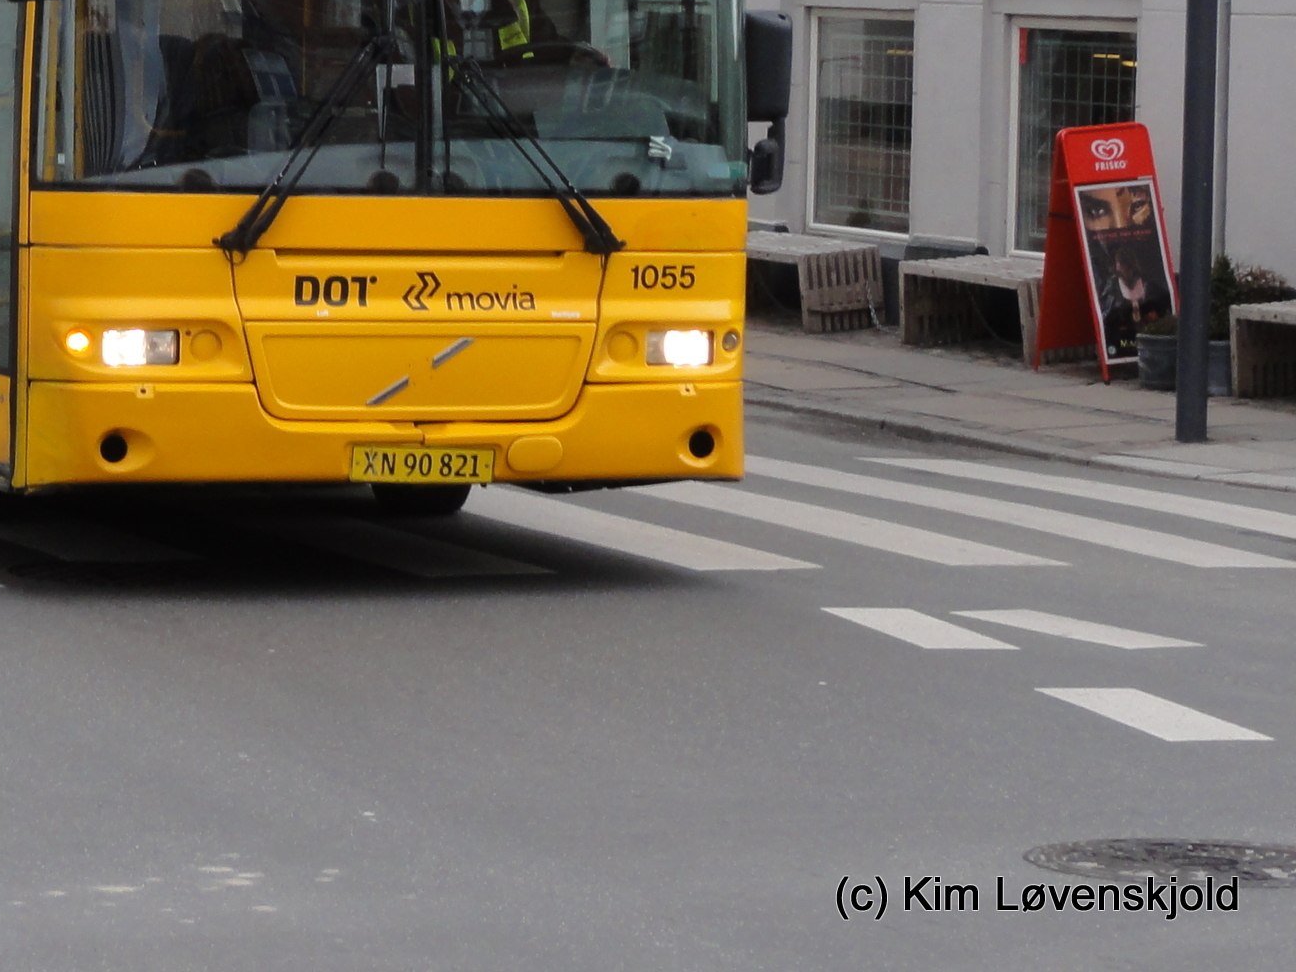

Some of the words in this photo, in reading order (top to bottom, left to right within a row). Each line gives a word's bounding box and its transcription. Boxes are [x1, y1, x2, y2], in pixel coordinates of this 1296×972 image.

[1095, 159, 1126, 171] FRISKO
[293, 275, 377, 307] DOT
[631, 264, 696, 291] 1055
[446, 284, 536, 312] movia
[363, 451, 397, 476] XN
[404, 453, 432, 476] 90
[439, 453, 480, 477] 821
